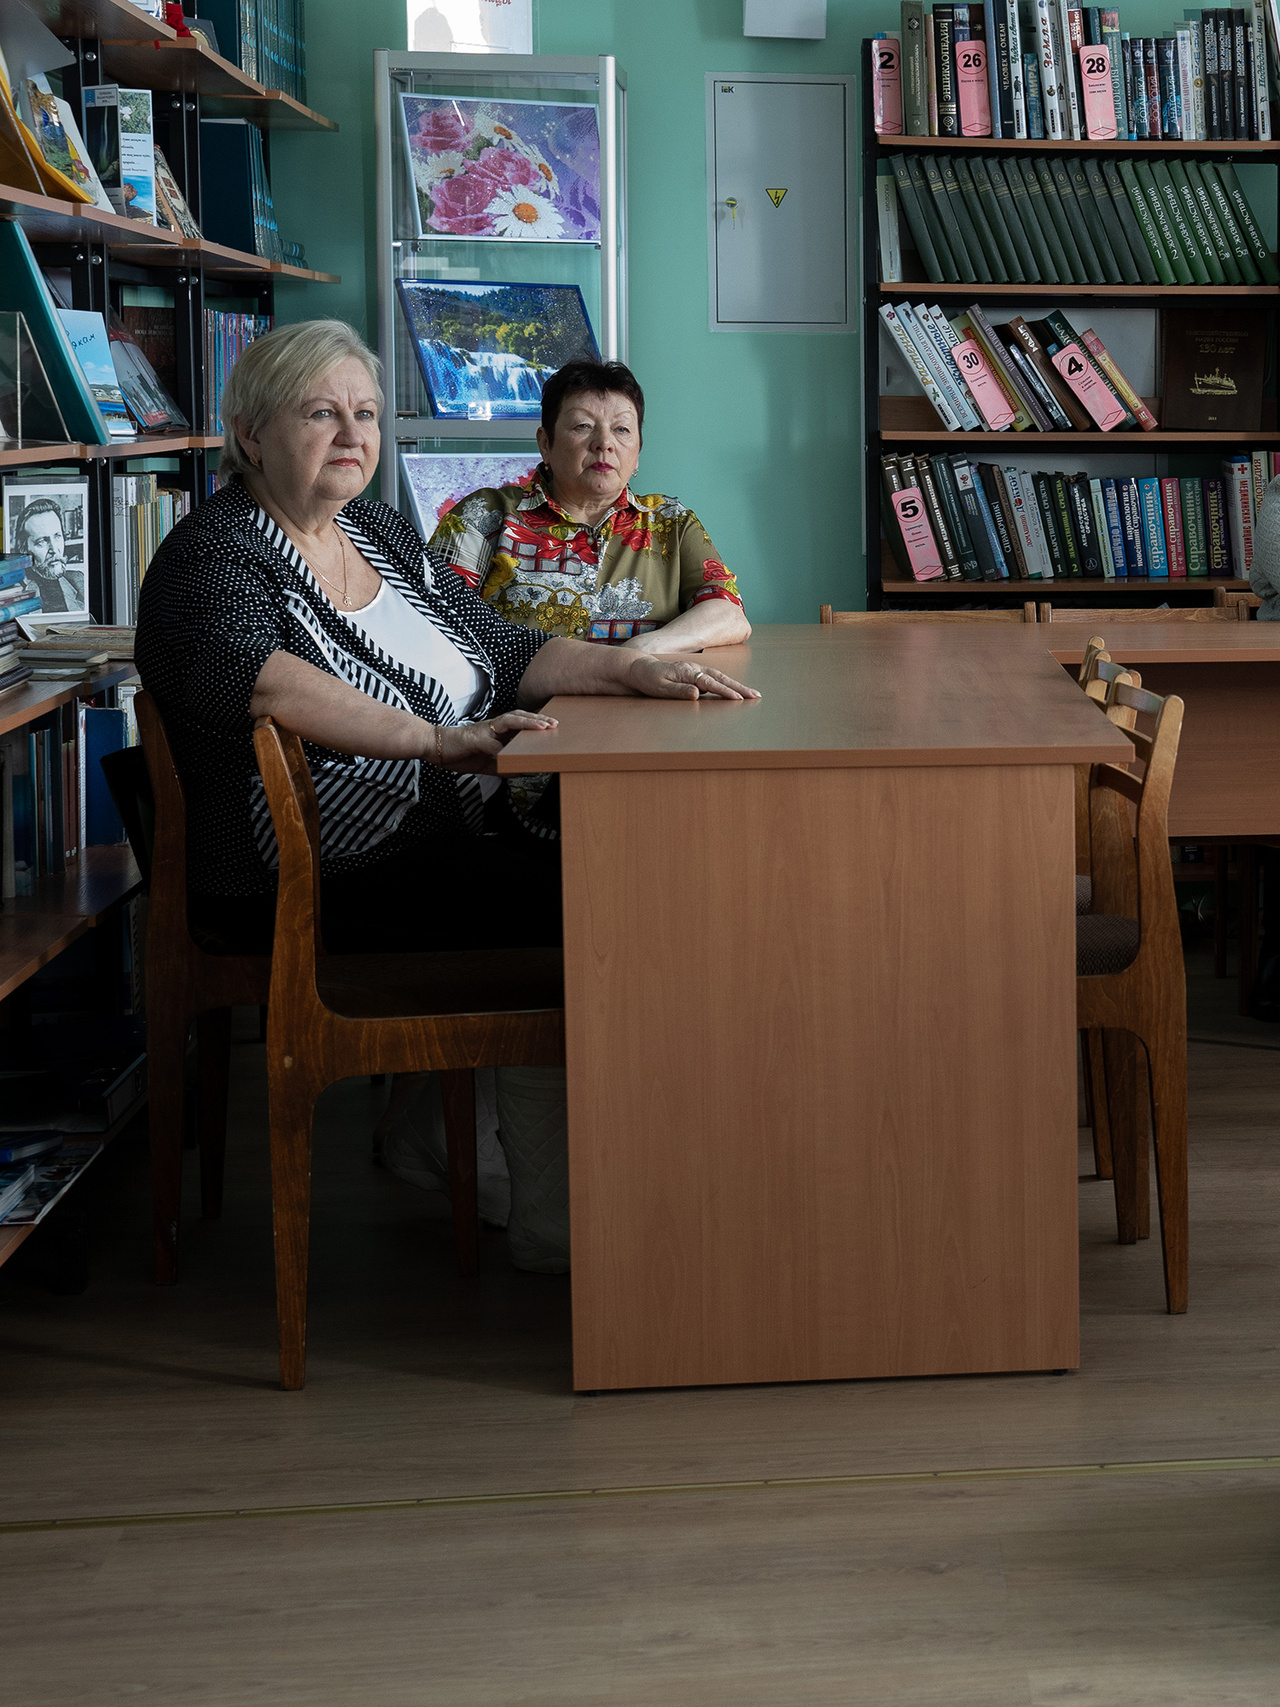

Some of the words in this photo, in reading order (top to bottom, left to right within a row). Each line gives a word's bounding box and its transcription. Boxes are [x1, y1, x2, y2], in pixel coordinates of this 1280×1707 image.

[1008, 36, 1020, 64] Чудеса
[1037, 16, 1054, 69] Земля
[878, 52, 894, 69] 2
[940, 22, 951, 101] ЭНЦИКЛОПЕДИЯ
[963, 54, 982, 68] 26
[1000, 58, 1010, 89] ЧЕЛОВЕК
[1086, 57, 1106, 74] 28
[1255, 37, 1266, 88] Подводный
[1027, 63, 1038, 98] МИРА
[1110, 69, 1122, 118] БИОЛОГИЯ
[1134, 75, 1149, 123] БОТАНИКА
[1147, 75, 1161, 123] ЗООЛОГИЯ
[1167, 75, 1178, 124] АНАТОМИЯ
[1132, 187, 1152, 225] РАСТЕНИЙ
[1148, 187, 1166, 225] РАСТЕНИЙ
[1164, 185, 1184, 224] РАСТЕНИЙ
[1182, 186, 1200, 224] РАСТЕНИЙ
[1197, 187, 1216, 225] РАСТЕНИЙ
[1212, 183, 1230, 220] РАСТЕНИЙ
[1234, 190, 1252, 226] РАСТЕНИЙ
[1146, 224, 1158, 249] ЖИЗНЬ
[1162, 224, 1175, 250] ЖИЗНЬ
[1179, 223, 1194, 248] ЖИЗНЬ
[1196, 224, 1209, 248] ЖИЗНЬ
[1211, 224, 1226, 248] ЖИЗНЬ
[1227, 220, 1242, 246] ЖИЗНЬ
[1247, 225, 1262, 249] ЖИЗНЬ
[1155, 250, 1162, 260] 1
[1172, 250, 1180, 261] 2
[1190, 248, 1197, 259] 3
[1206, 247, 1214, 258] 4
[1259, 250, 1267, 259] 6
[909, 323, 925, 341] ПТИЦ
[1200, 344, 1216, 353] 130
[893, 324, 935, 387] Растения
[918, 340, 950, 385] ЭНЦИКЛОПЕДИЯ
[925, 322, 967, 386] Животные
[963, 352, 980, 369] 30
[1068, 356, 1083, 376] 4
[944, 384, 969, 418] ВСЕМИРНАЯ
[923, 474, 940, 508] ЭНЦИКЛОПЕДИЯ
[1040, 480, 1049, 509] СРЕДСТВА
[1056, 480, 1066, 509] СРЕДСТВА
[1106, 487, 1119, 527] СПРАВОЧНИК
[1127, 484, 1140, 528] справочник
[1237, 480, 1252, 523] МЕДИЦИНСКАЯ
[901, 500, 919, 518] 5
[933, 508, 949, 540] МЕДИЦИНСКАЯ
[1080, 498, 1090, 534] СРЕДСТВА
[1122, 491, 1136, 540] наркология
[1045, 511, 1060, 558] ЛЕКАРСТВЕННЫЕ
[1062, 510, 1076, 558] ЛЕКАРСТВЕННЫЕ
[1183, 490, 1206, 570] Справочник
[1195, 505, 1204, 549] медицинской
[1132, 528, 1142, 566] новейший
[1169, 544, 1177, 570] полный
